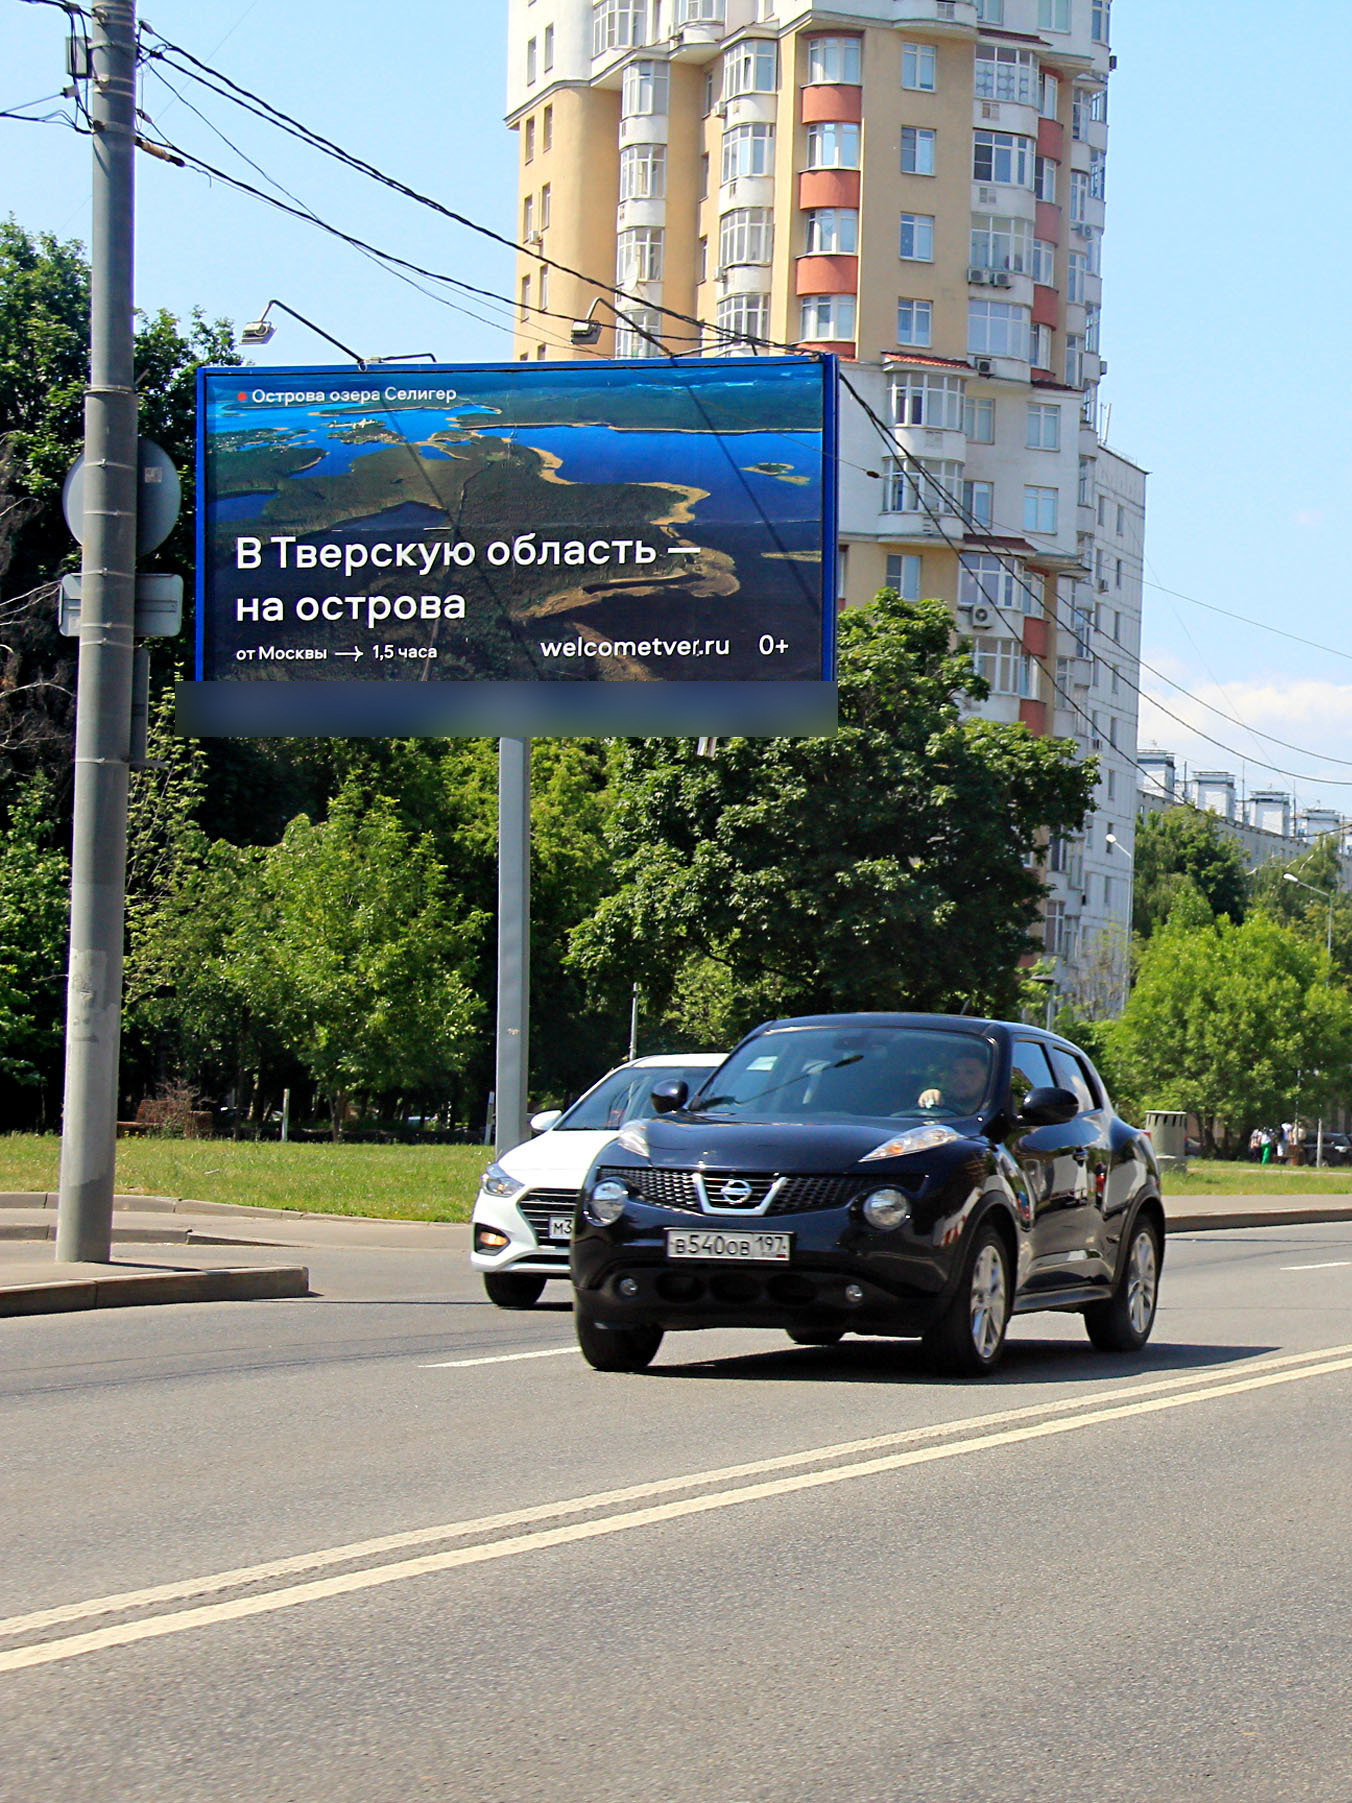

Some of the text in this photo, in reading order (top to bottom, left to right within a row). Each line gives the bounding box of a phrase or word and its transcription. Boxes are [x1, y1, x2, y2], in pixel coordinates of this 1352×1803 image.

[252, 386, 457, 406] Острова озера Селигер
[236, 536, 262, 569] В
[270, 535, 476, 577] Тверскую
[487, 532, 657, 566] область
[236, 593, 466, 629] на острова
[236, 644, 438, 661] от Москвы 1,5 часа
[540, 636, 730, 657] welcometver.ru
[759, 634, 789, 655] 0+
[755, 1235, 784, 1251] 197
